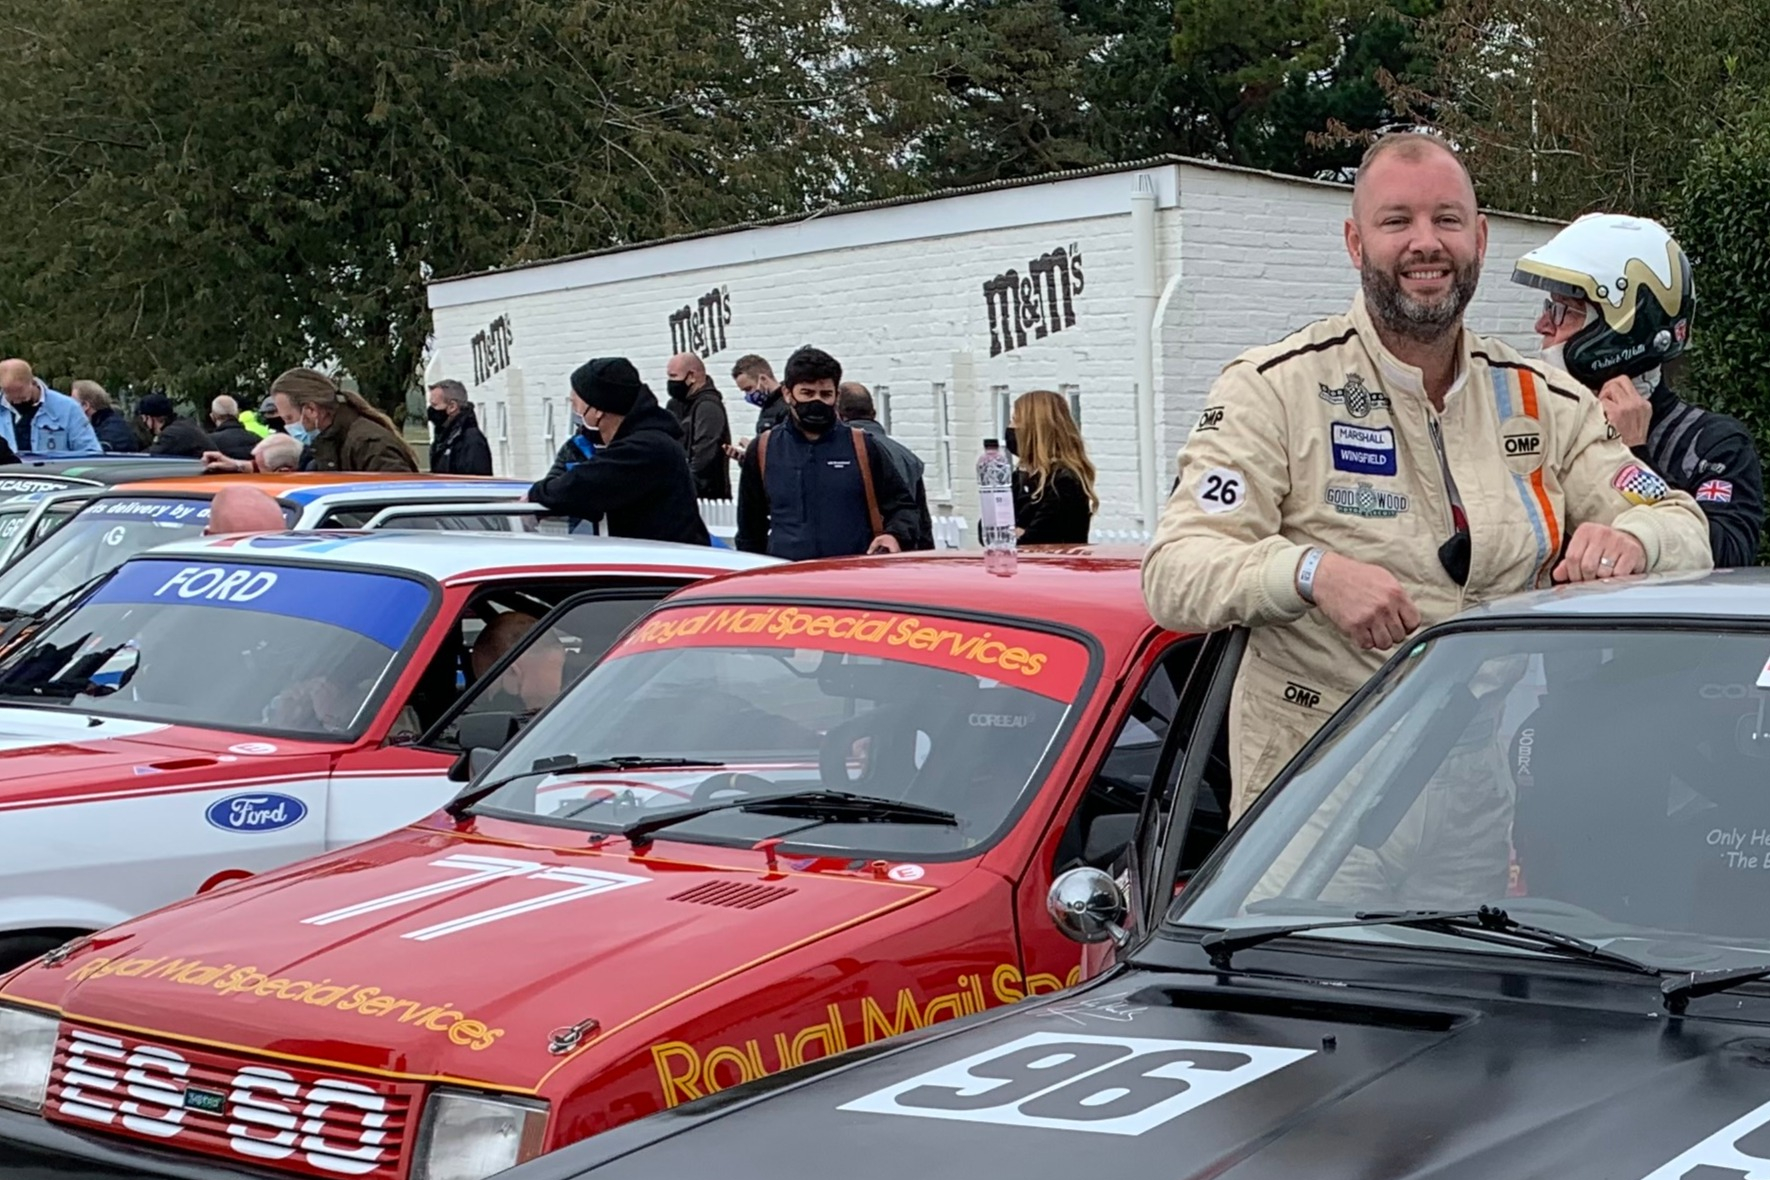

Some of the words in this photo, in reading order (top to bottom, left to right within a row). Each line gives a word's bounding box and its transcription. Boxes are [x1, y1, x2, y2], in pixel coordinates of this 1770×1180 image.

[1199, 409, 1224, 428] OMP
[1339, 428, 1385, 445] MARSHALL
[1504, 437, 1540, 453] OMP
[1340, 449, 1387, 466] WINGFIELD
[1202, 475, 1239, 505] 26
[106, 502, 171, 517] delivery
[169, 504, 195, 519] by
[153, 567, 278, 602] FORD
[638, 610, 713, 645] Royal
[711, 607, 776, 634] Mail
[769, 607, 896, 642] Special
[888, 617, 1048, 677] Services
[1284, 685, 1320, 708] OMP
[1517, 728, 1535, 775] COBRA
[229, 797, 288, 827] Ford
[1706, 828, 1746, 849] Only
[1727, 851, 1758, 869] The
[301, 854, 654, 941] 77
[157, 957, 221, 984] Mail
[213, 963, 360, 1006] Special
[338, 983, 506, 1052] Services
[860, 972, 987, 1044] Mail
[894, 1042, 1253, 1122] 96
